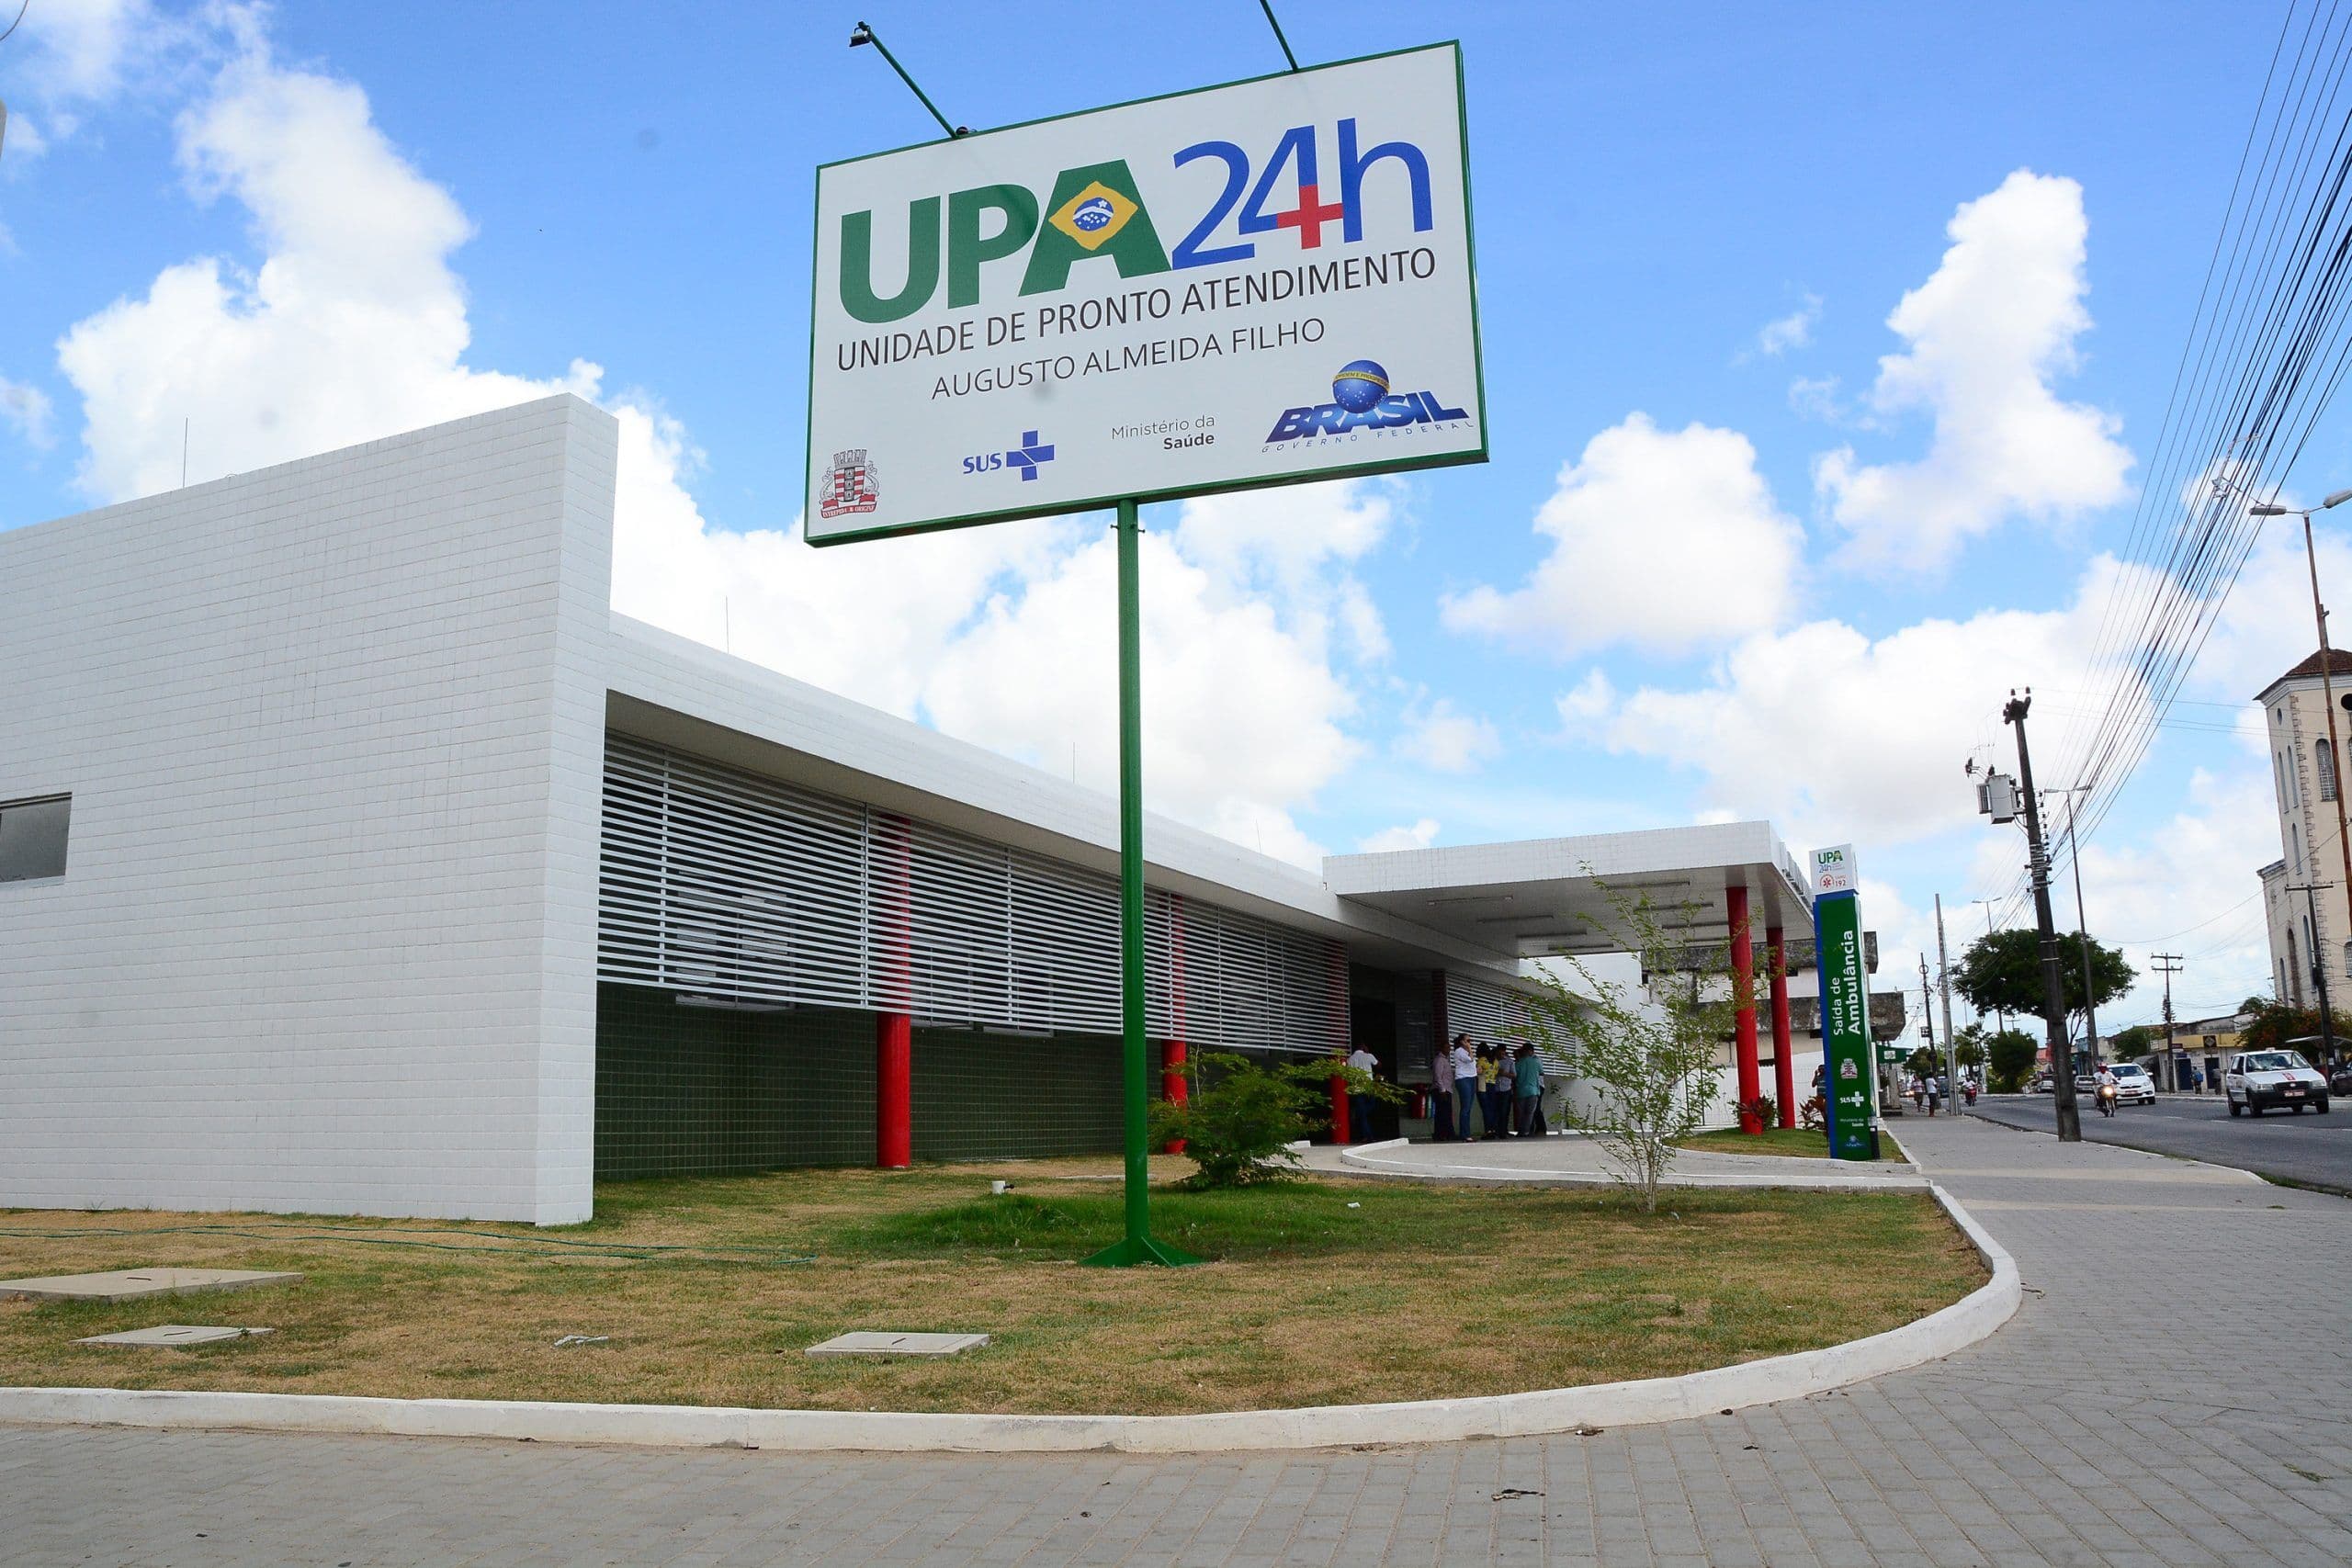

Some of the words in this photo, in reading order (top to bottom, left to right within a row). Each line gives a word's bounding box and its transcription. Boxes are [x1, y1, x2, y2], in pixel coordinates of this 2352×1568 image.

[840, 158, 1170, 323] UPA
[1171, 117, 1433, 270] 24h
[837, 321, 975, 371] UNIDADE
[987, 311, 1025, 347] DE
[1039, 288, 1171, 338] PRONTO
[1181, 247, 1437, 315] ATENDIMENTO
[931, 355, 1075, 400] AUGUSTO
[1082, 333, 1223, 376] ALMEIDA
[1232, 317, 1325, 354] FILHO
[1111, 419, 1190, 440] Ministério
[1194, 414, 1216, 429] da
[1265, 390, 1470, 444] BRASIL
[1163, 433, 1216, 451] Saúde
[1261, 434, 1358, 454] GOVERNO
[1376, 420, 1475, 439] FEDERAL
[962, 451, 1002, 475] SUS
[1817, 850, 1844, 864] UPA
[1830, 976, 1841, 995] de
[1840, 931, 1861, 1035] Ambulância
[1832, 998, 1844, 1036] Saída
